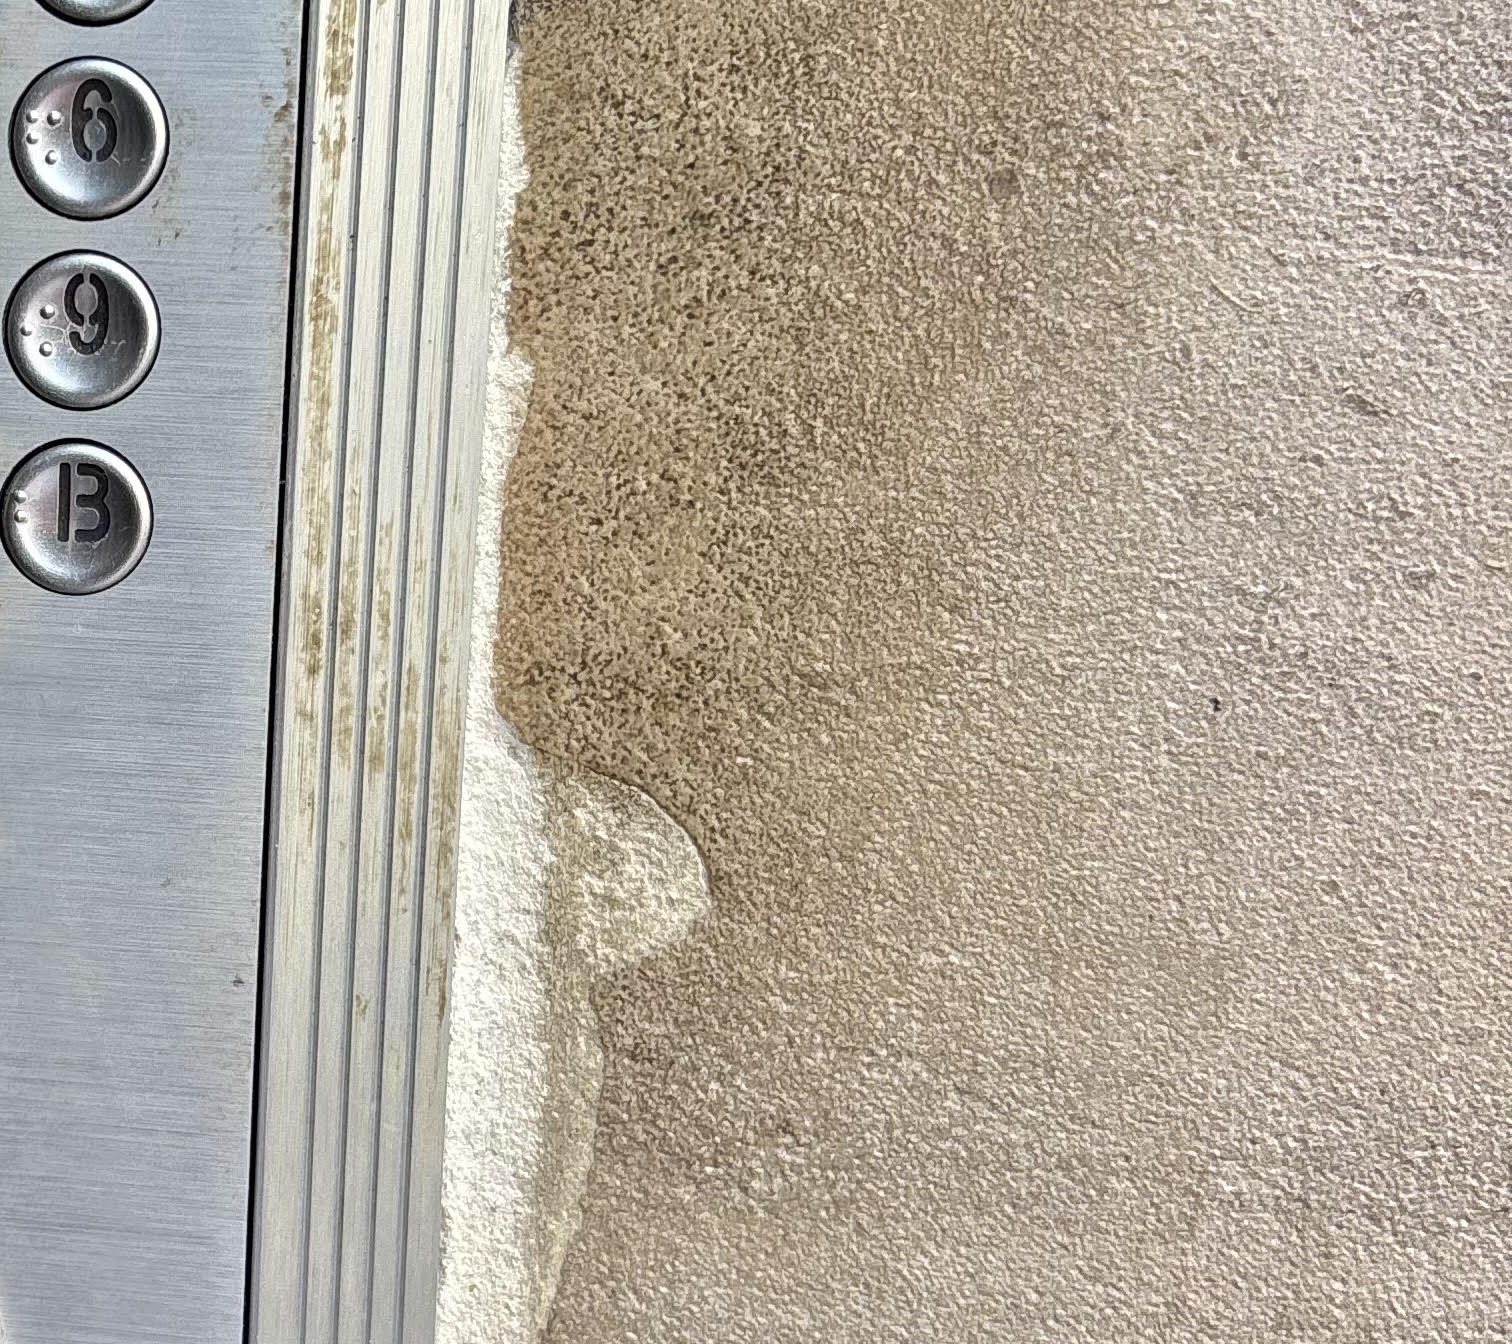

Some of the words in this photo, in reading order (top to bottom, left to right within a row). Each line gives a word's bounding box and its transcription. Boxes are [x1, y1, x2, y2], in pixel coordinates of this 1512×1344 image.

[71, 79, 116, 163] 6
[63, 273, 110, 354] 9
[57, 462, 111, 543] B
